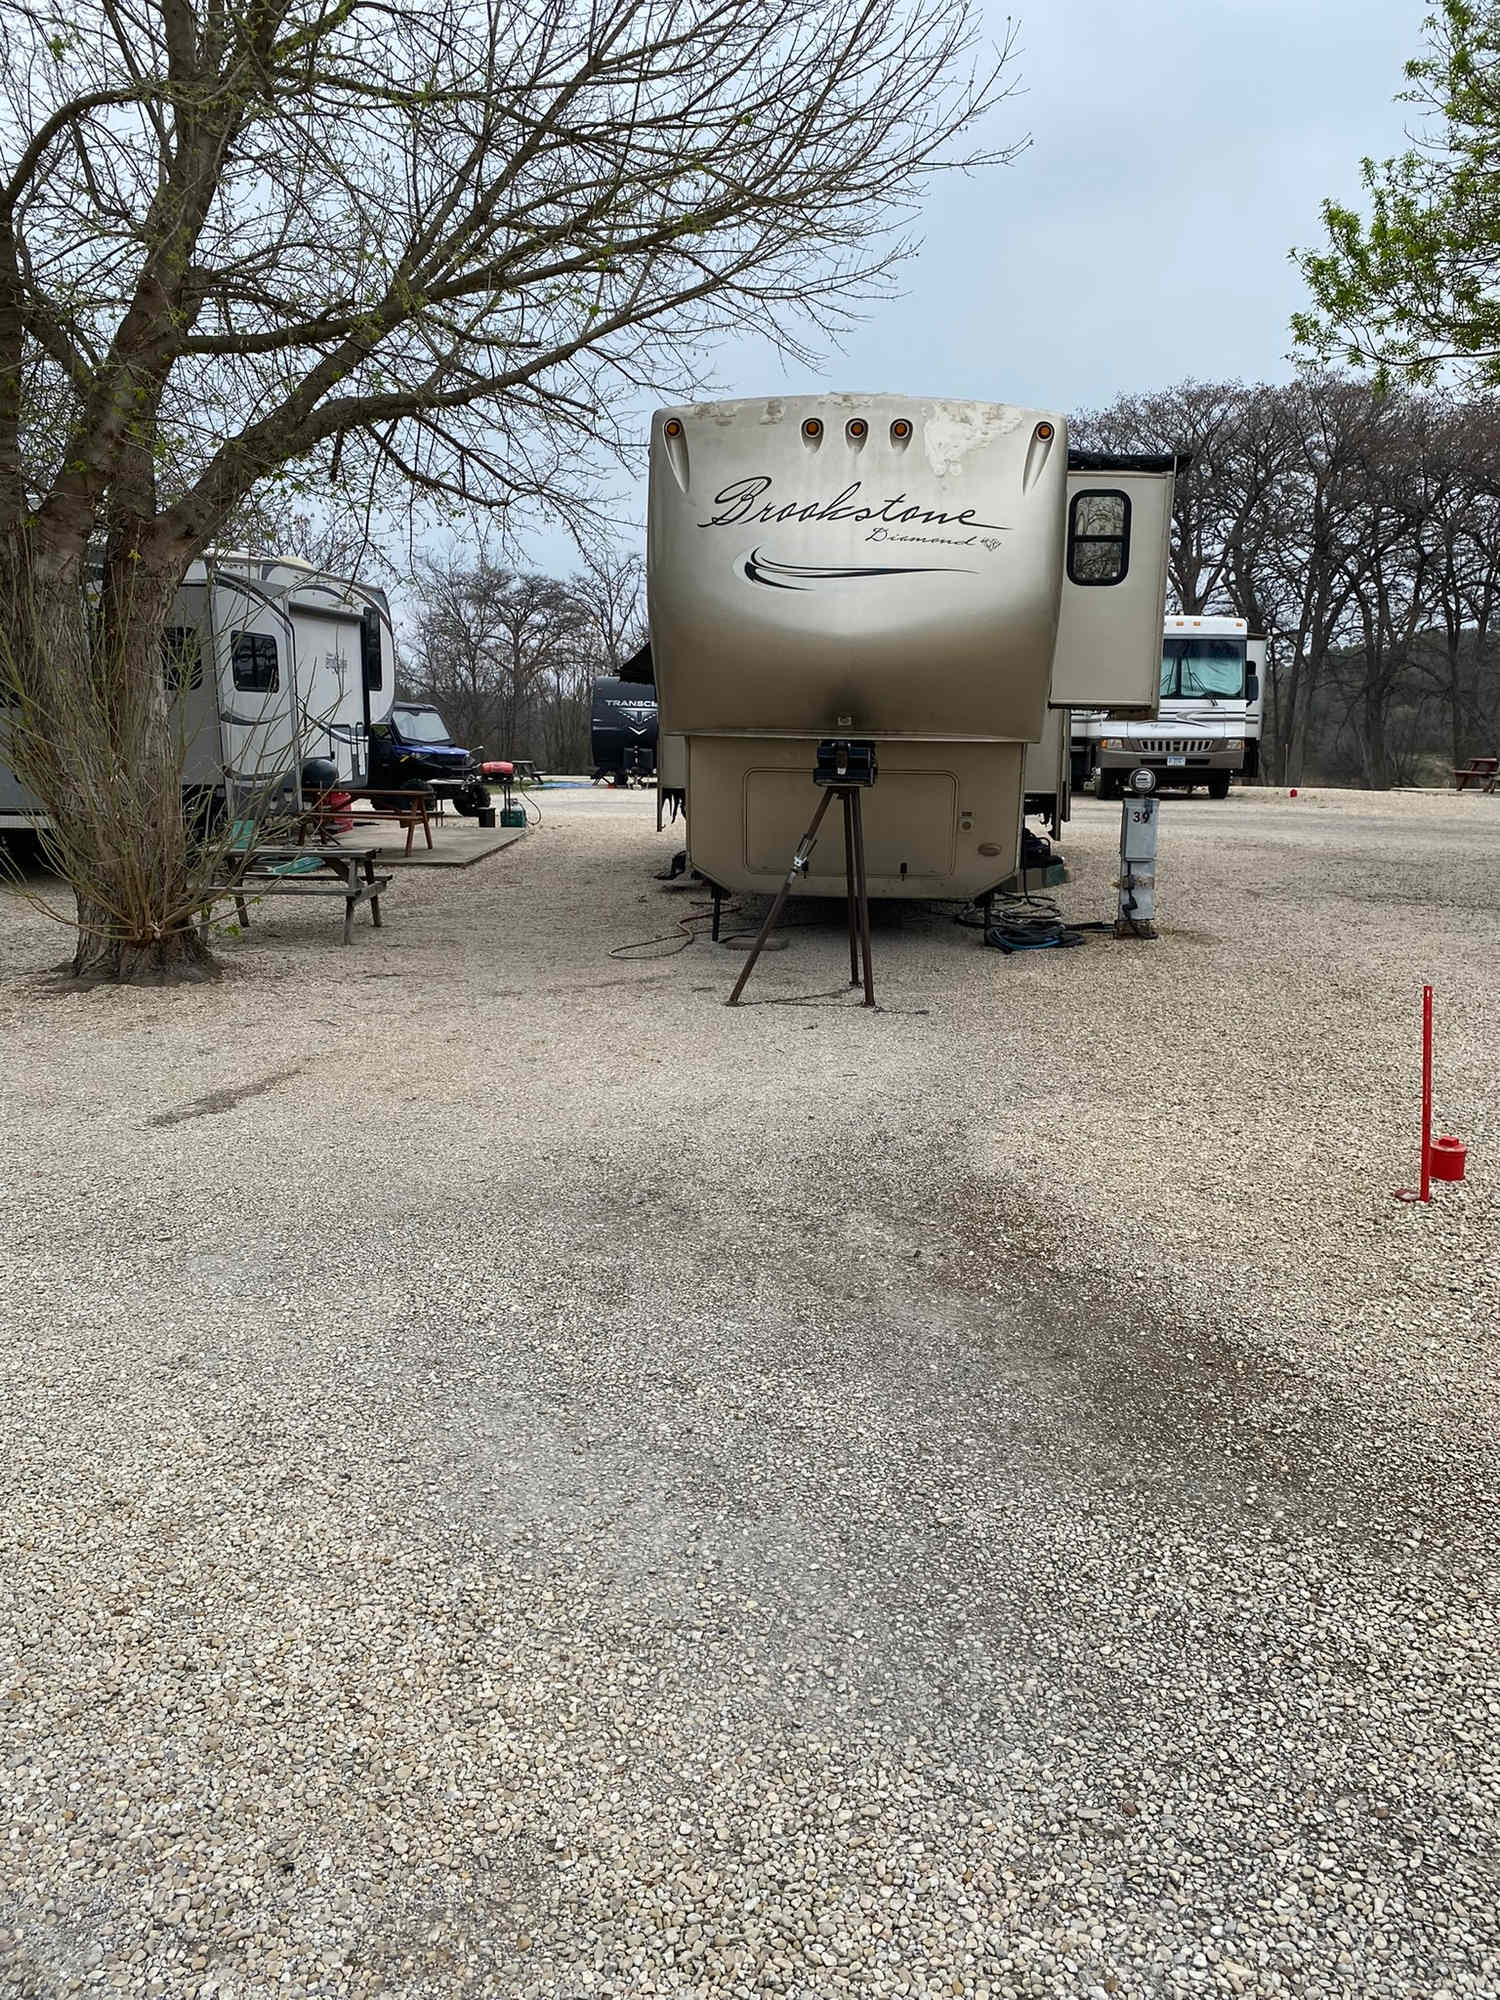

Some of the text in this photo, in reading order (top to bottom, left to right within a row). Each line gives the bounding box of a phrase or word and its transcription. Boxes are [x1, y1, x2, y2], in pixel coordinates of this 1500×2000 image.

[698, 476, 1013, 529] Brookstone
[865, 527, 976, 546] Diamond
[1132, 811, 1150, 824] 39
